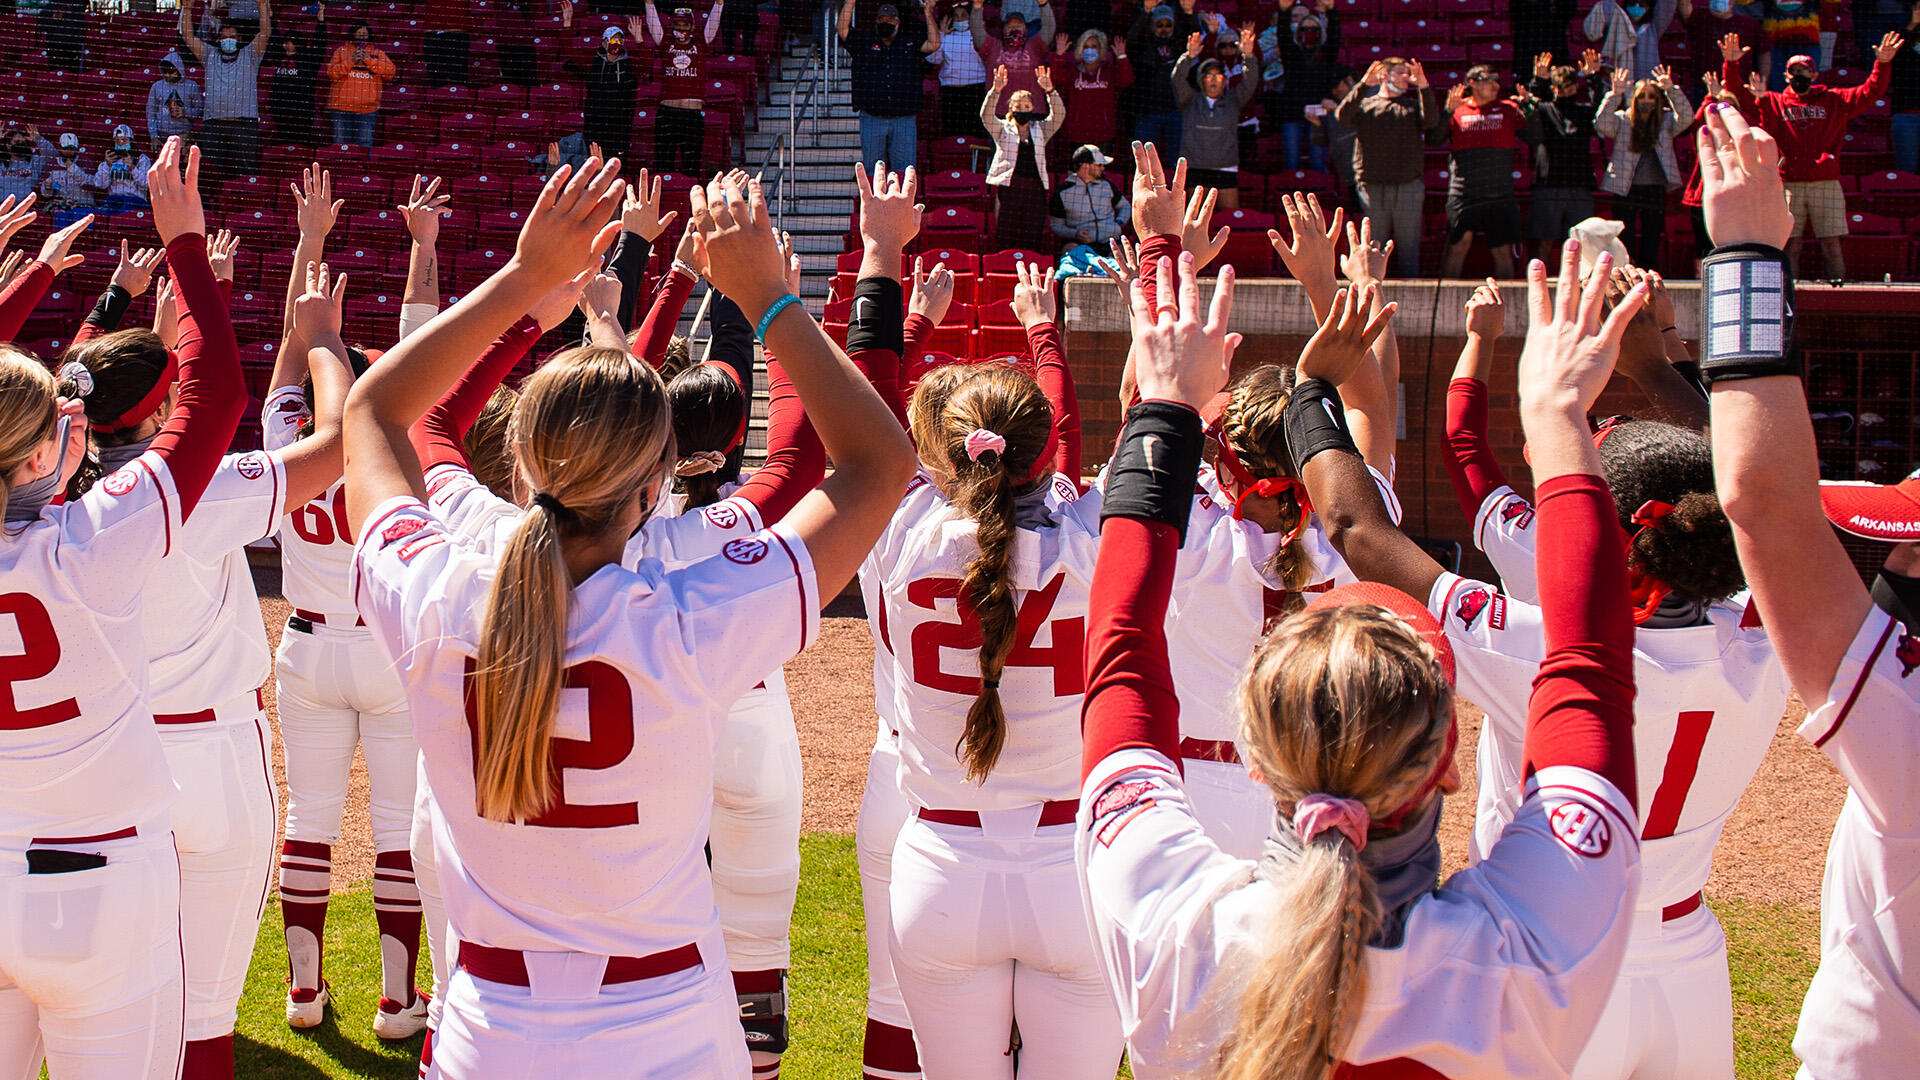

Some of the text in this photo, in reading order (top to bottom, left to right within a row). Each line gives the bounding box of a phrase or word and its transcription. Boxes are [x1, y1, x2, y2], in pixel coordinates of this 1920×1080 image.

[1849, 514, 1920, 532] ARKANSAS
[907, 571, 1086, 697] 24
[1551, 803, 1609, 855] SEC
